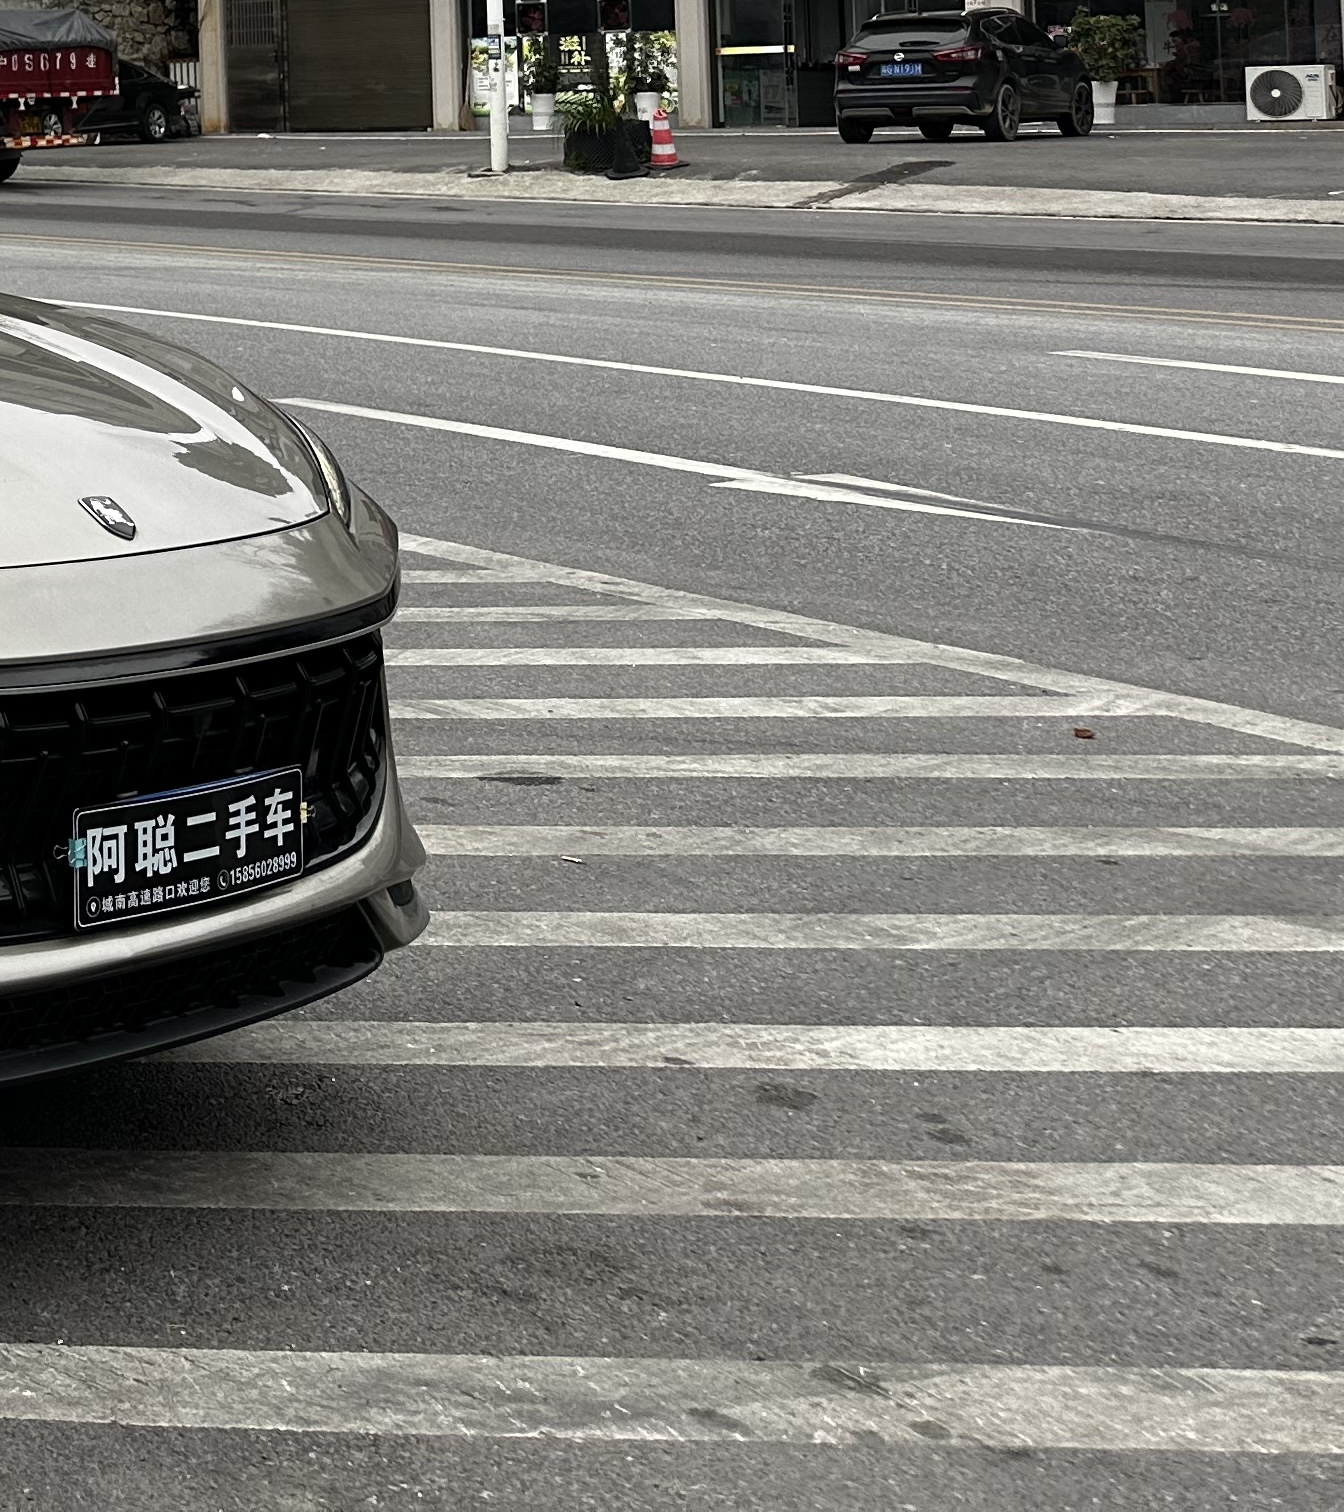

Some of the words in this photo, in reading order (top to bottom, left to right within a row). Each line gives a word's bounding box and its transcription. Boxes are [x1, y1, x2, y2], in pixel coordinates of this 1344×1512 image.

[86, 788, 294, 887] 阿聪二手车
[229, 851, 297, 886] 15856028999
